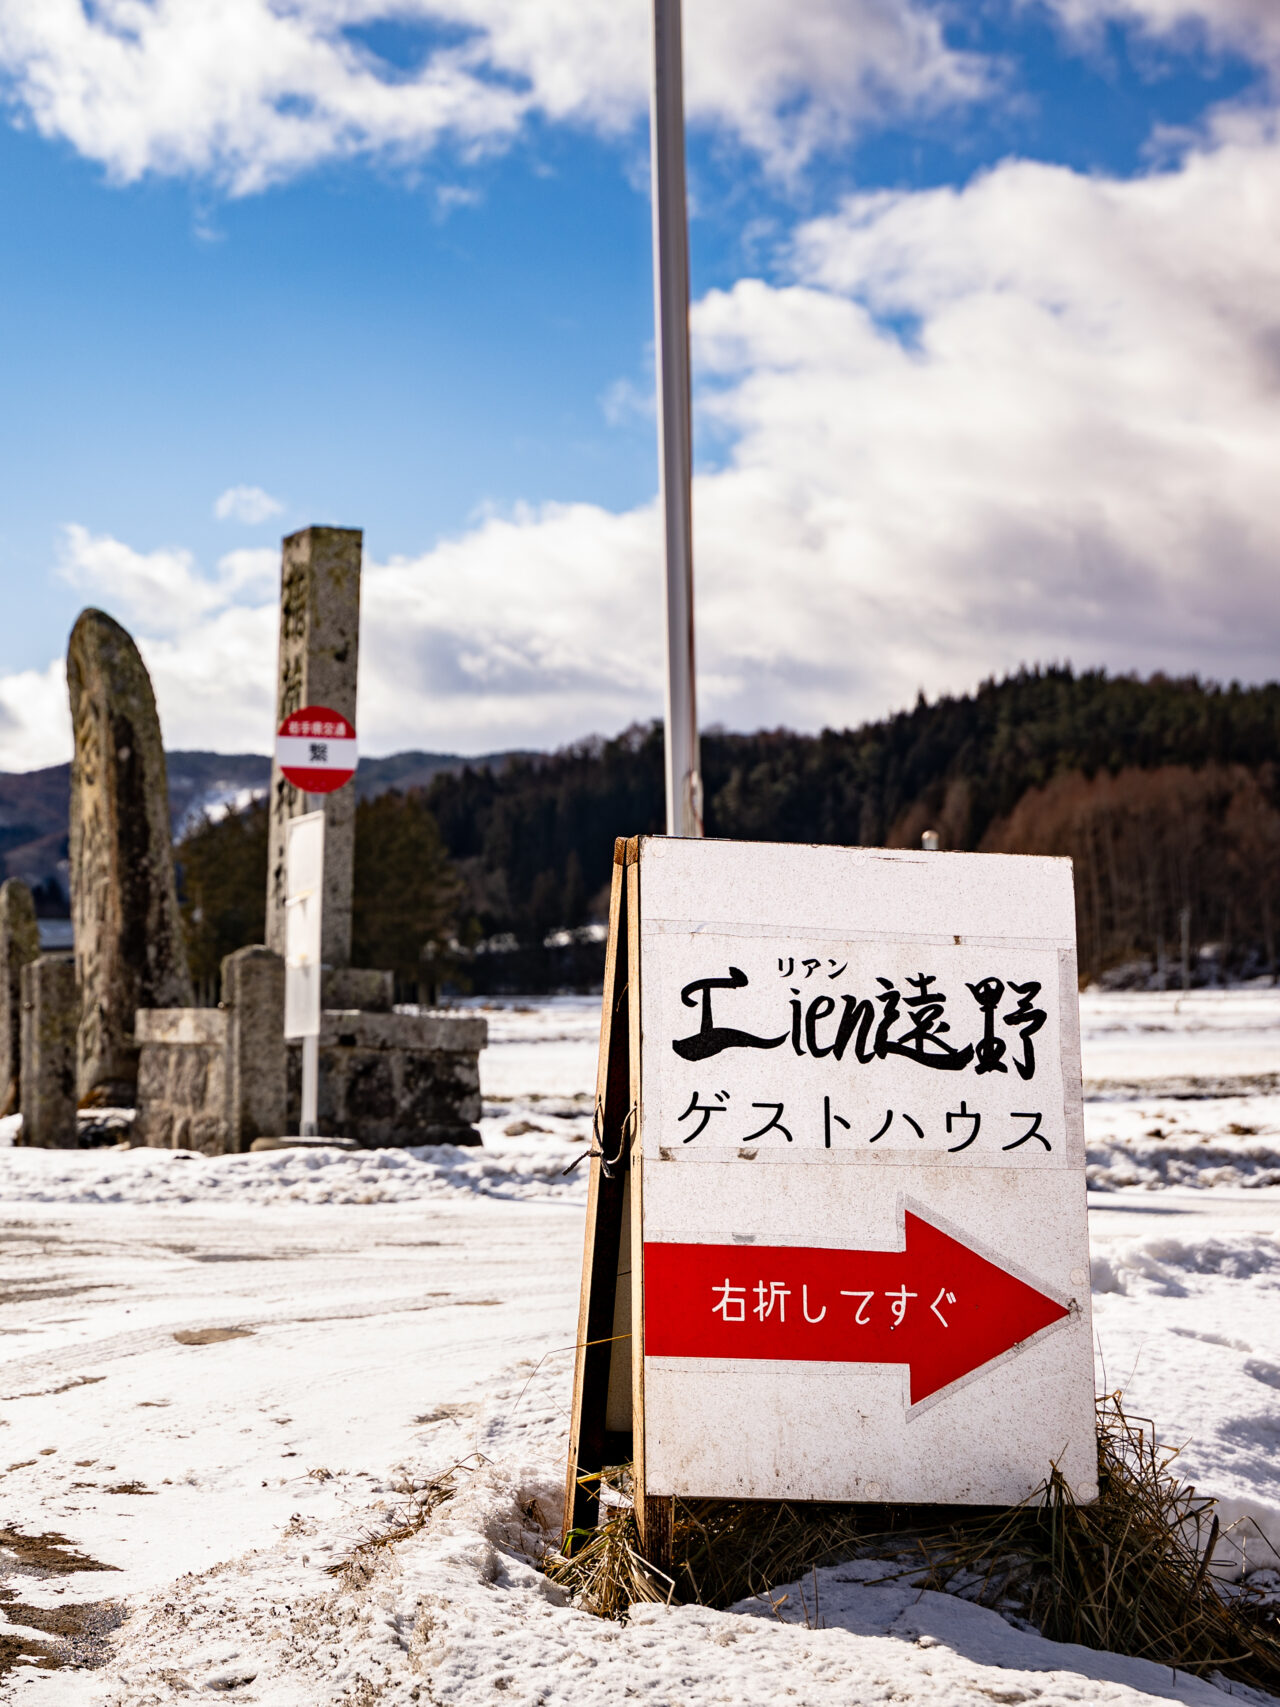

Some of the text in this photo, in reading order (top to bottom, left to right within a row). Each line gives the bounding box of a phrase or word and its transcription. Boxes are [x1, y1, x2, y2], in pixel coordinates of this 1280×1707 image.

[777, 957, 848, 980] リアン
[677, 1090, 1052, 1153] ゲストハウス
[711, 1278, 957, 1328] 右折してすぐ
